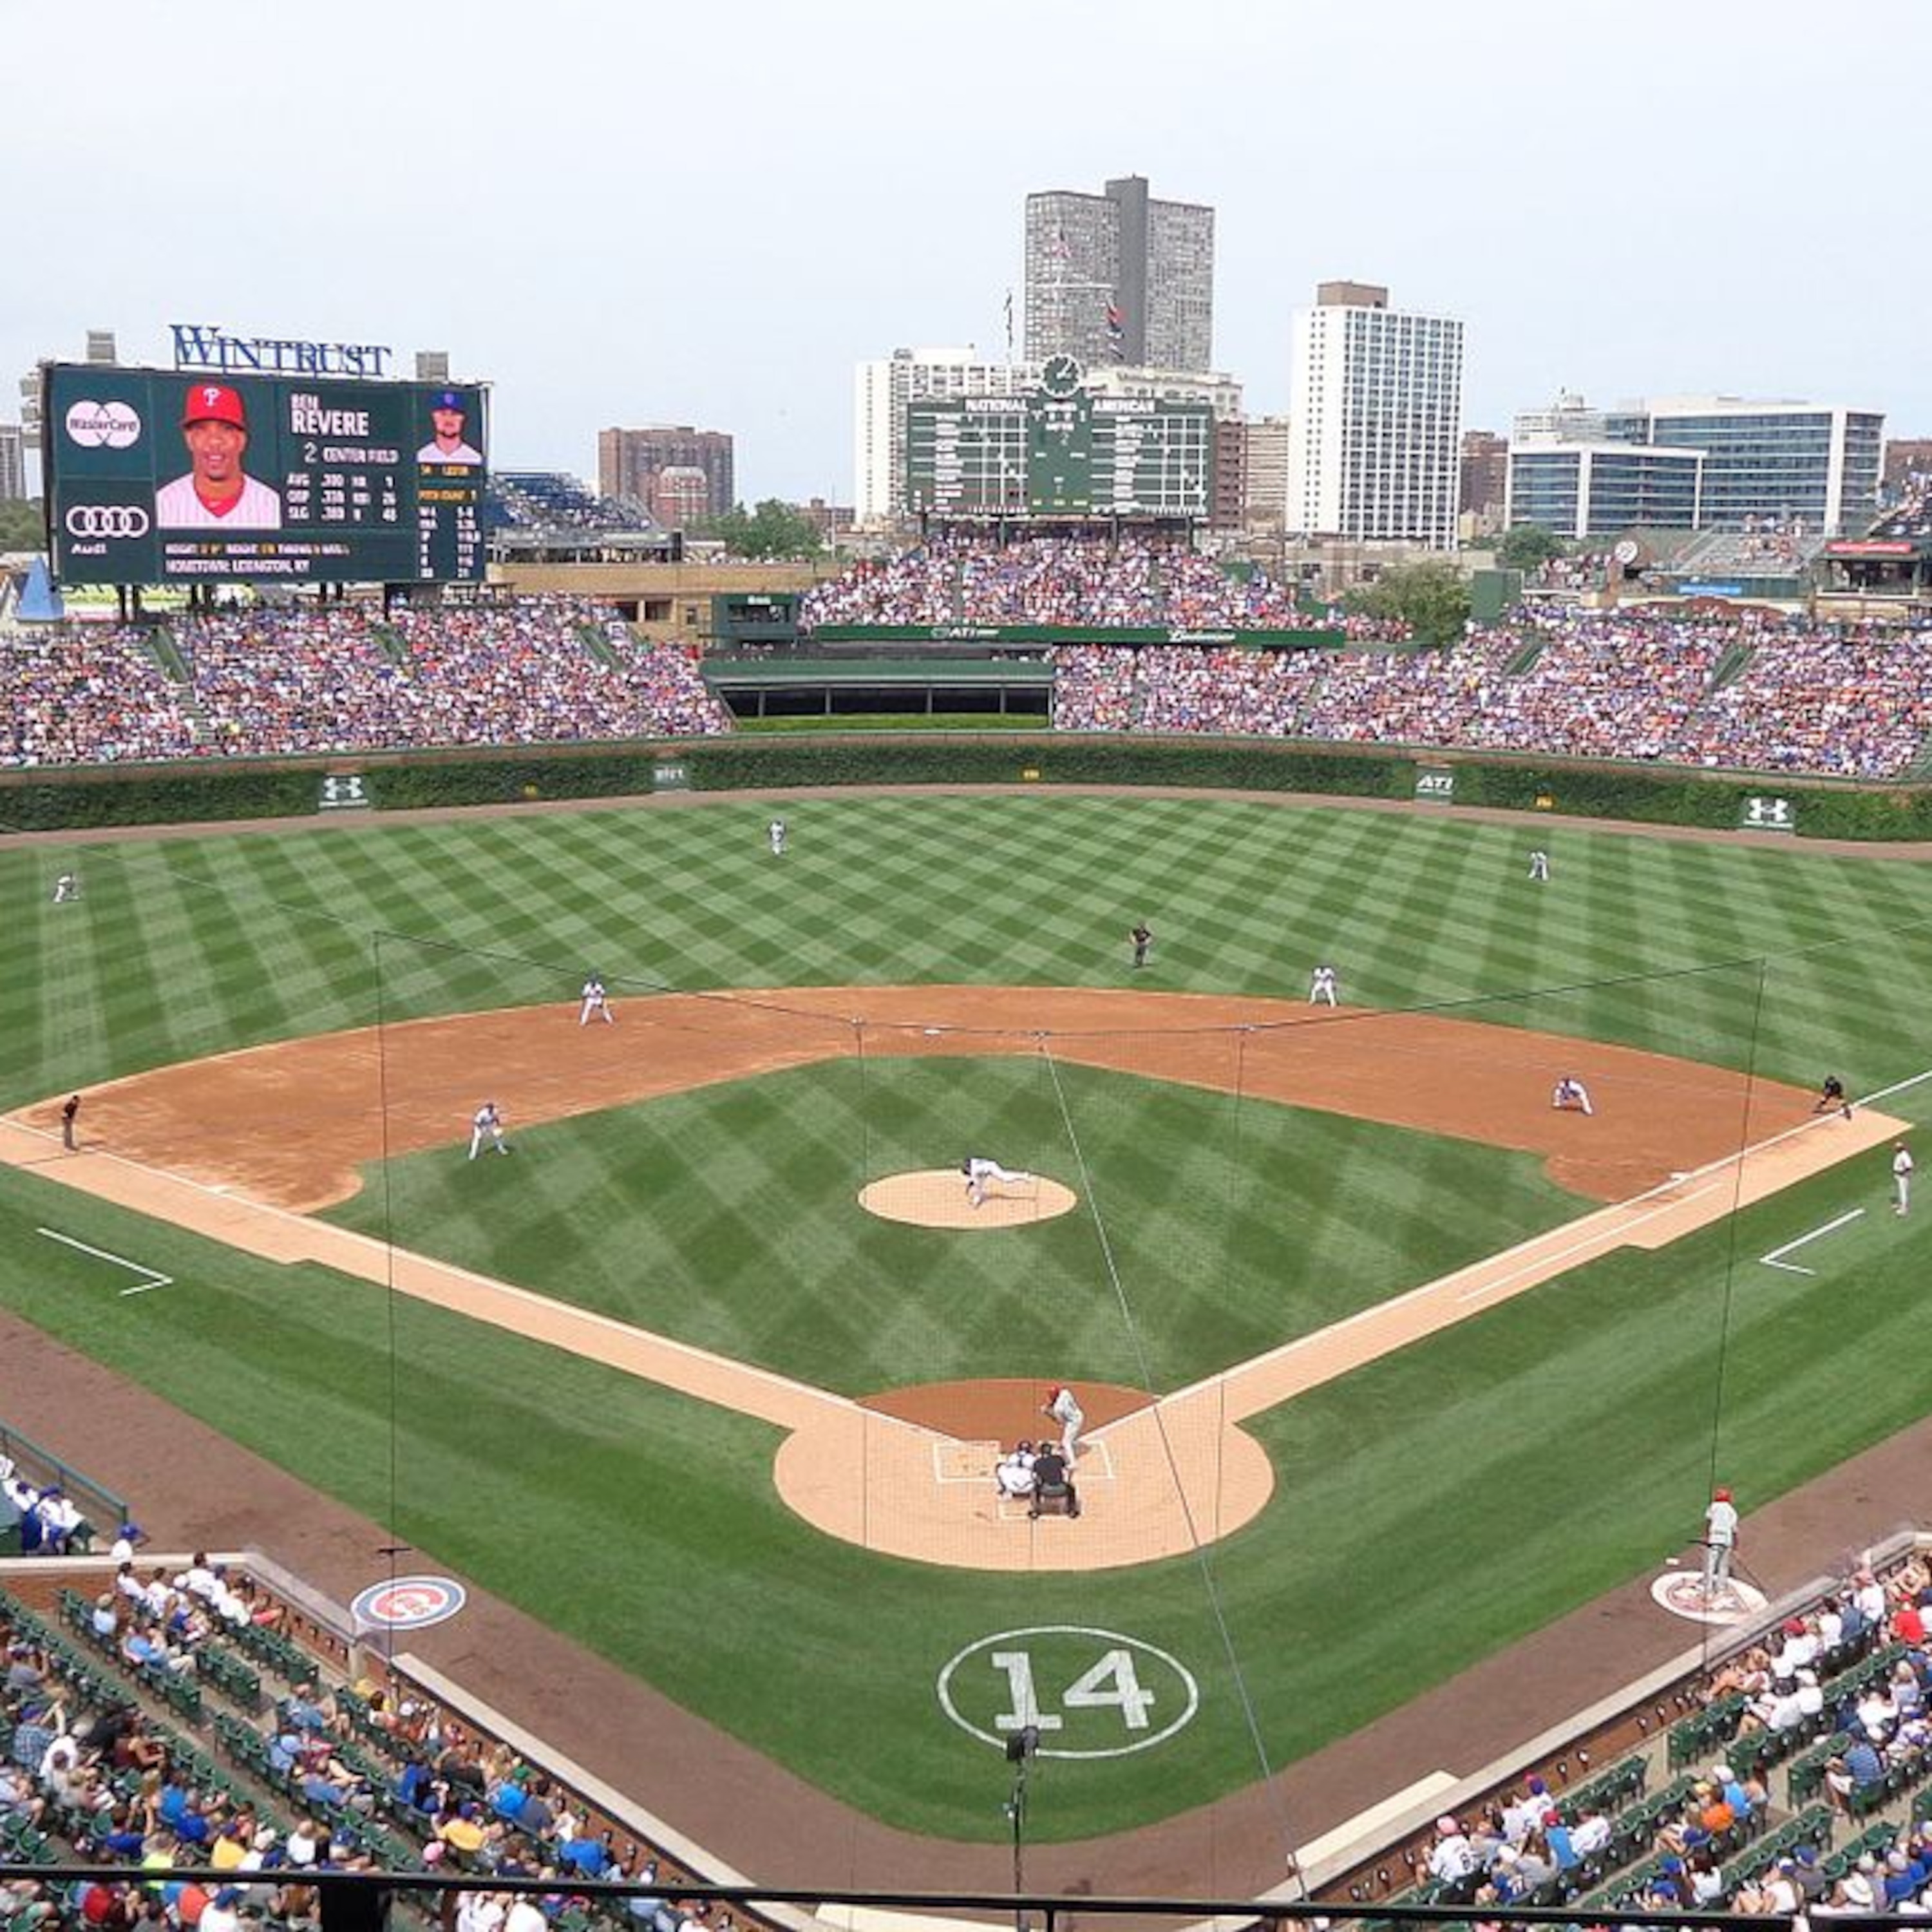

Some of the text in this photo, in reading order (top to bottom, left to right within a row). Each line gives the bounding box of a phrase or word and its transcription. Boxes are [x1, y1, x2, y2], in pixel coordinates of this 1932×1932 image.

[291, 393, 318, 409] BEN
[965, 399, 1029, 412] NATIONAL
[1092, 399, 1155, 412] AMERICAN
[291, 409, 369, 437] REVERE
[304, 442, 317, 463] 2
[288, 506, 310, 520] SLG
[71, 544, 108, 554] Audi
[1417, 774, 1454, 791] ATI
[991, 1649, 1155, 1729] 14
